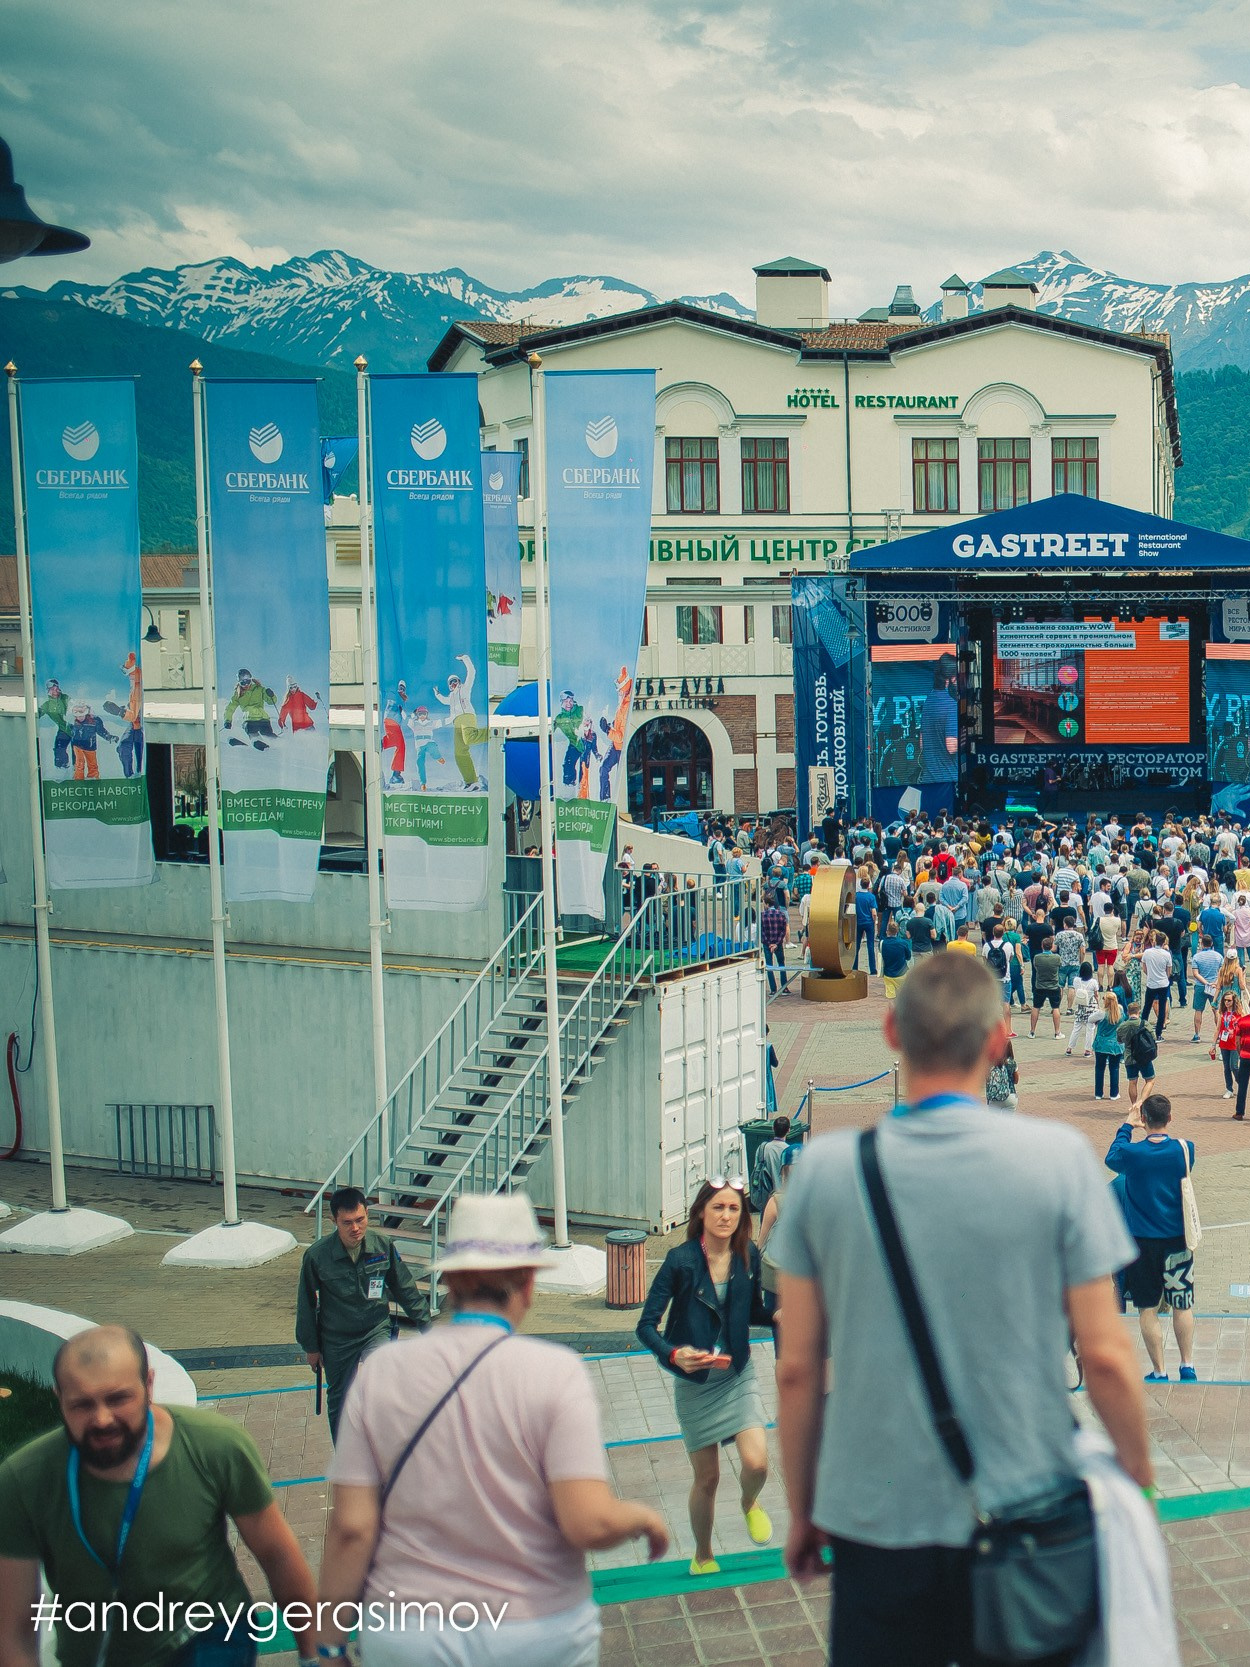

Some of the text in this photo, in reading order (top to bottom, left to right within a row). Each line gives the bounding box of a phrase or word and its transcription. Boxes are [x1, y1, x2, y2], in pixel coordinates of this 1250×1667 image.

[787, 394, 959, 408] HOTEL RESTAURANT
[36, 469, 128, 485] СБЕРБАНК
[225, 472, 309, 489] СБЕРБАНК
[387, 469, 473, 486] СБЕРБАНК
[562, 467, 640, 484] СБЕРБАНК
[59, 490, 108, 500] Всегда рядом
[408, 492, 454, 502] Всегда рядом
[1138, 533, 1187, 541] International
[952, 533, 1129, 558] GASTREET
[1138, 541, 1181, 549] Restaurant
[751, 539, 838, 564] ЦЕНТР
[632, 700, 647, 710] AR
[815, 672, 829, 743] ГОТОВЬ.
[829, 685, 848, 800] ДОХНОВЛЯЙ.
[51, 786, 94, 797] ВМЕСТЕ
[51, 801, 117, 811] РЕКОРДАМ!
[226, 797, 324, 810] ВМЕСТЕ НАВСТРЕЧУ
[421, 803, 483, 815] НАВСТРЕЧУ
[281, 828, 321, 836] www.sberbank.r
[428, 835, 484, 843] www.sberbank.ru
